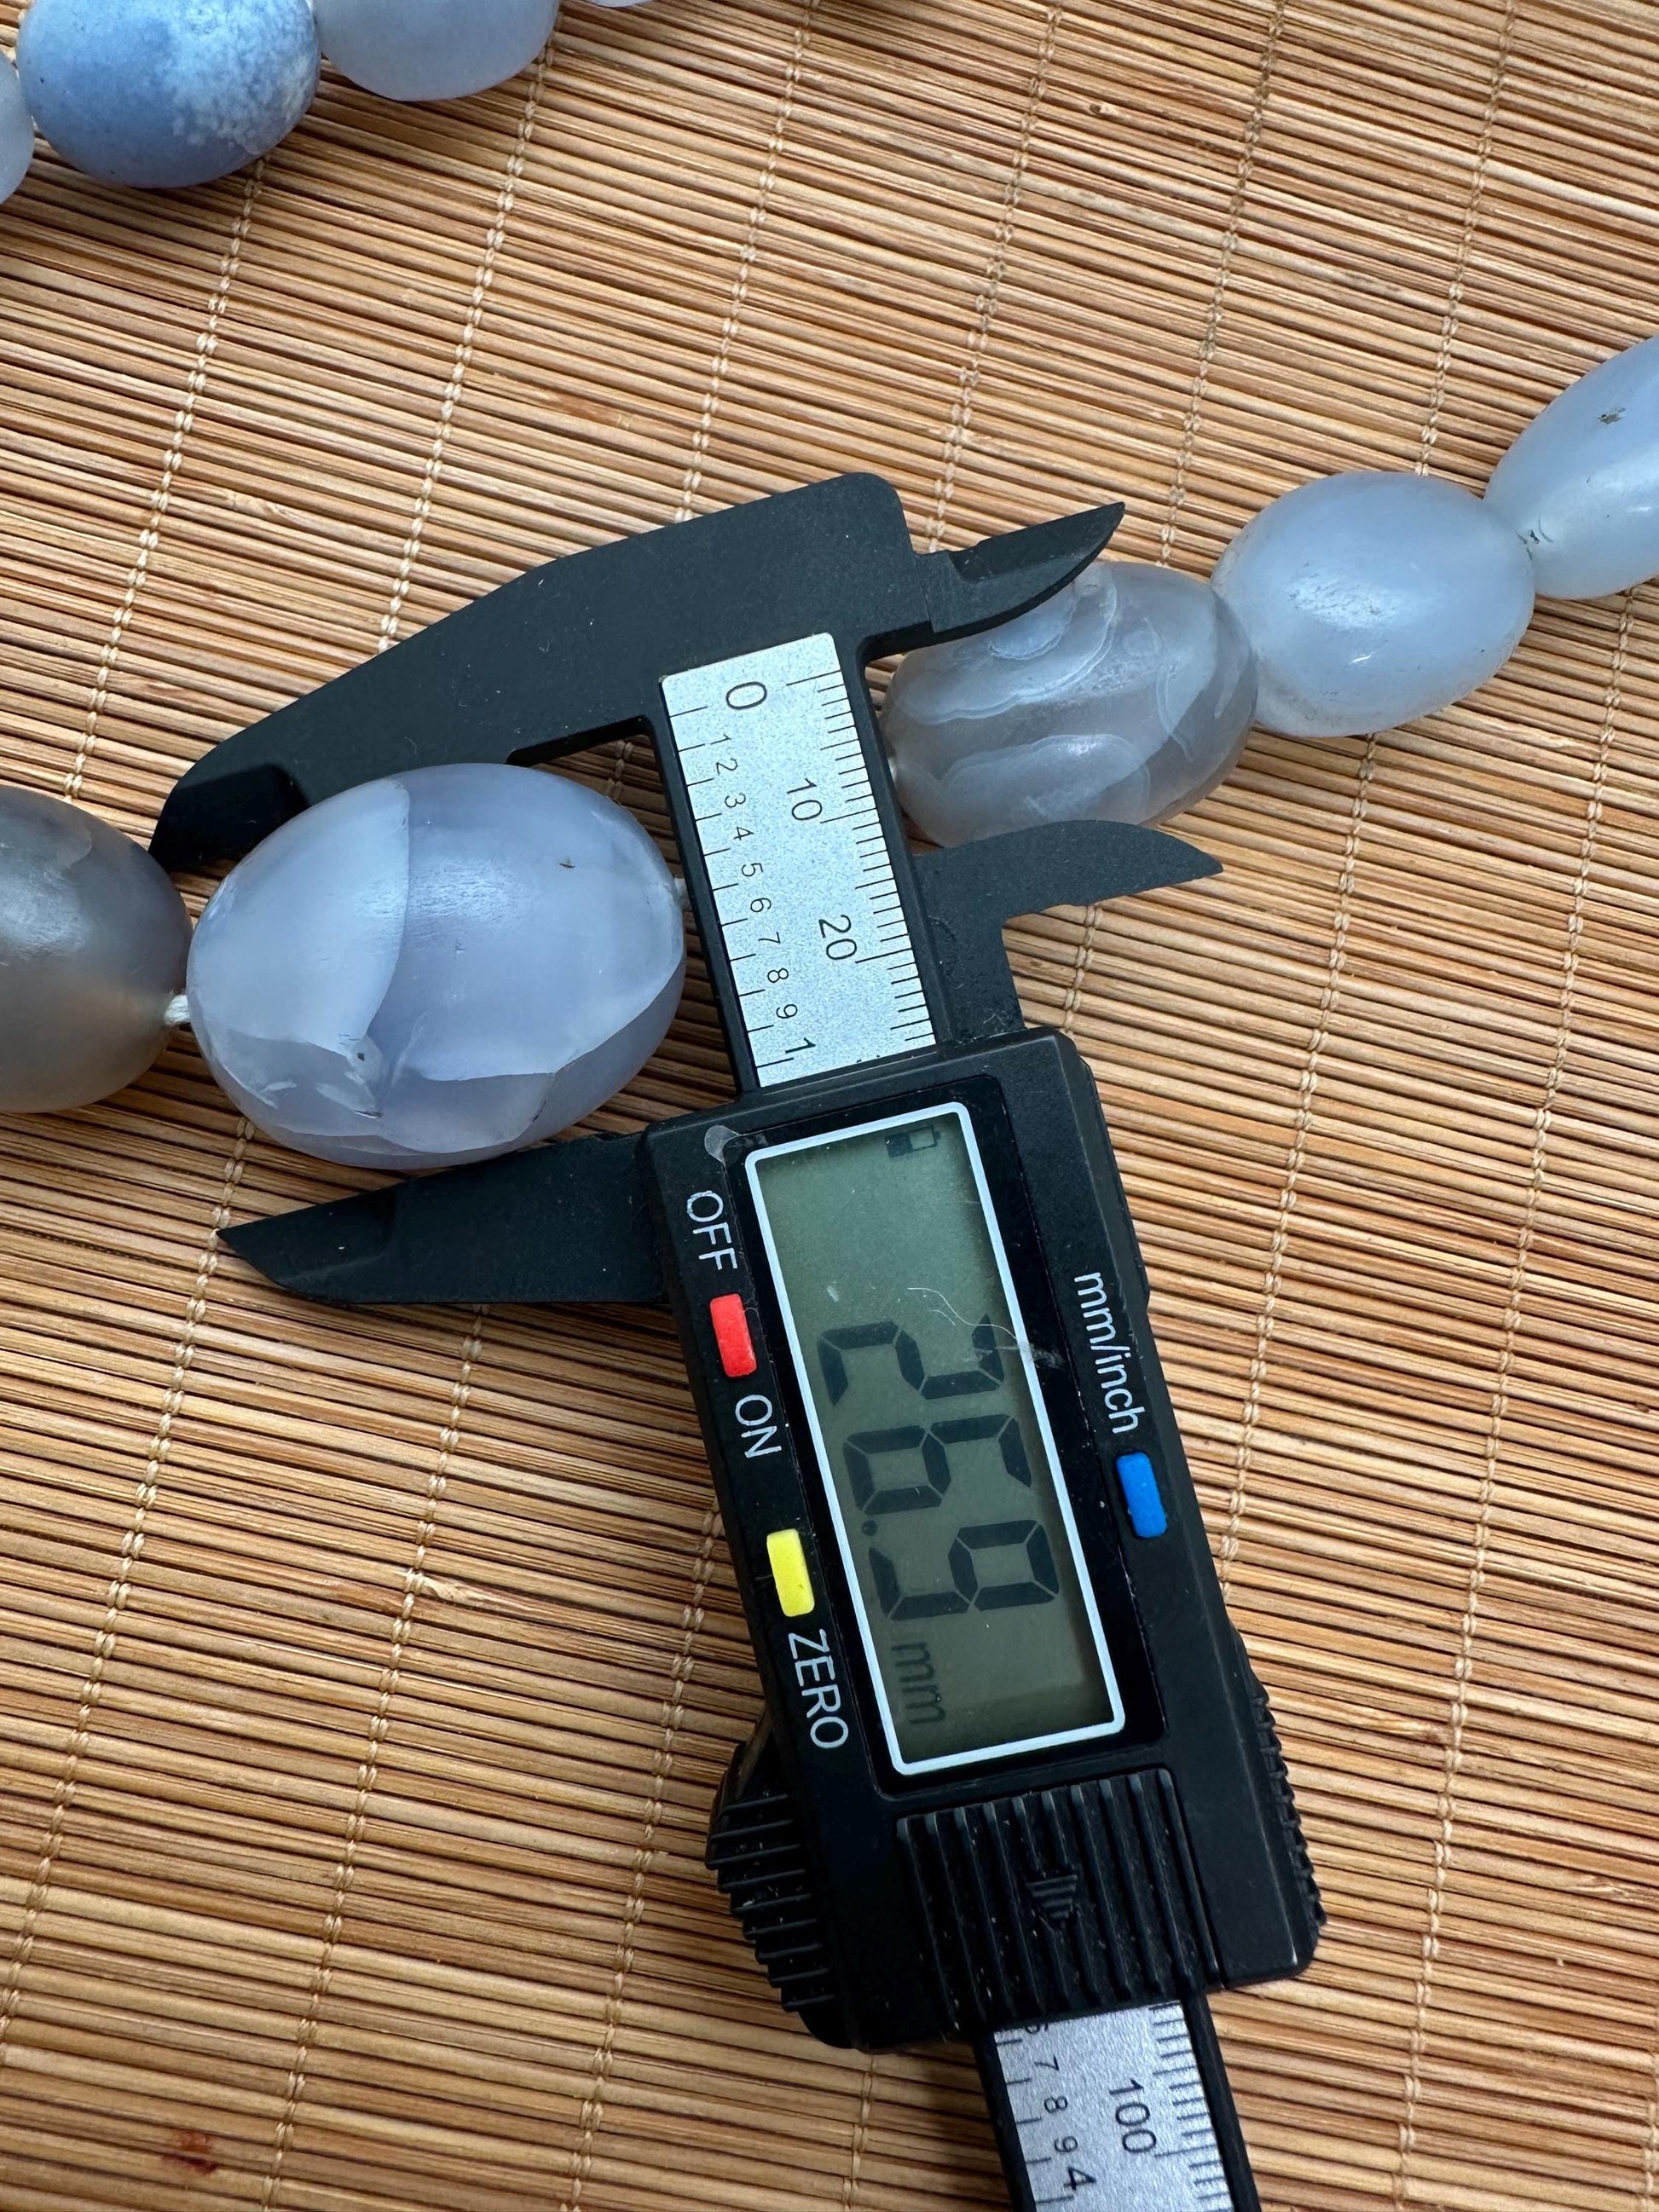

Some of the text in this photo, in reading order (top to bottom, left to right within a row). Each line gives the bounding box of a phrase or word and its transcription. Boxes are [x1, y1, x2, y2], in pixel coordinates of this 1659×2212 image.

[725, 681, 858, 961] 0 10 20
[710, 733, 817, 1054] 1 2 3 4 5 6 7 8 9 1
[686, 1189, 738, 1272] OFF
[1073, 1271, 1145, 1434] mm/inch
[734, 1394, 783, 1459] ON
[817, 1314, 1060, 1726] 26.9 mm
[788, 1628, 849, 1751] ZERO
[1034, 2055, 1060, 2072] 7
[1043, 2095, 1068, 2114] 8
[1054, 2135, 1078, 2153] 9
[1109, 2077, 1157, 2153] 100
[1063, 2166, 1097, 2191] 4
